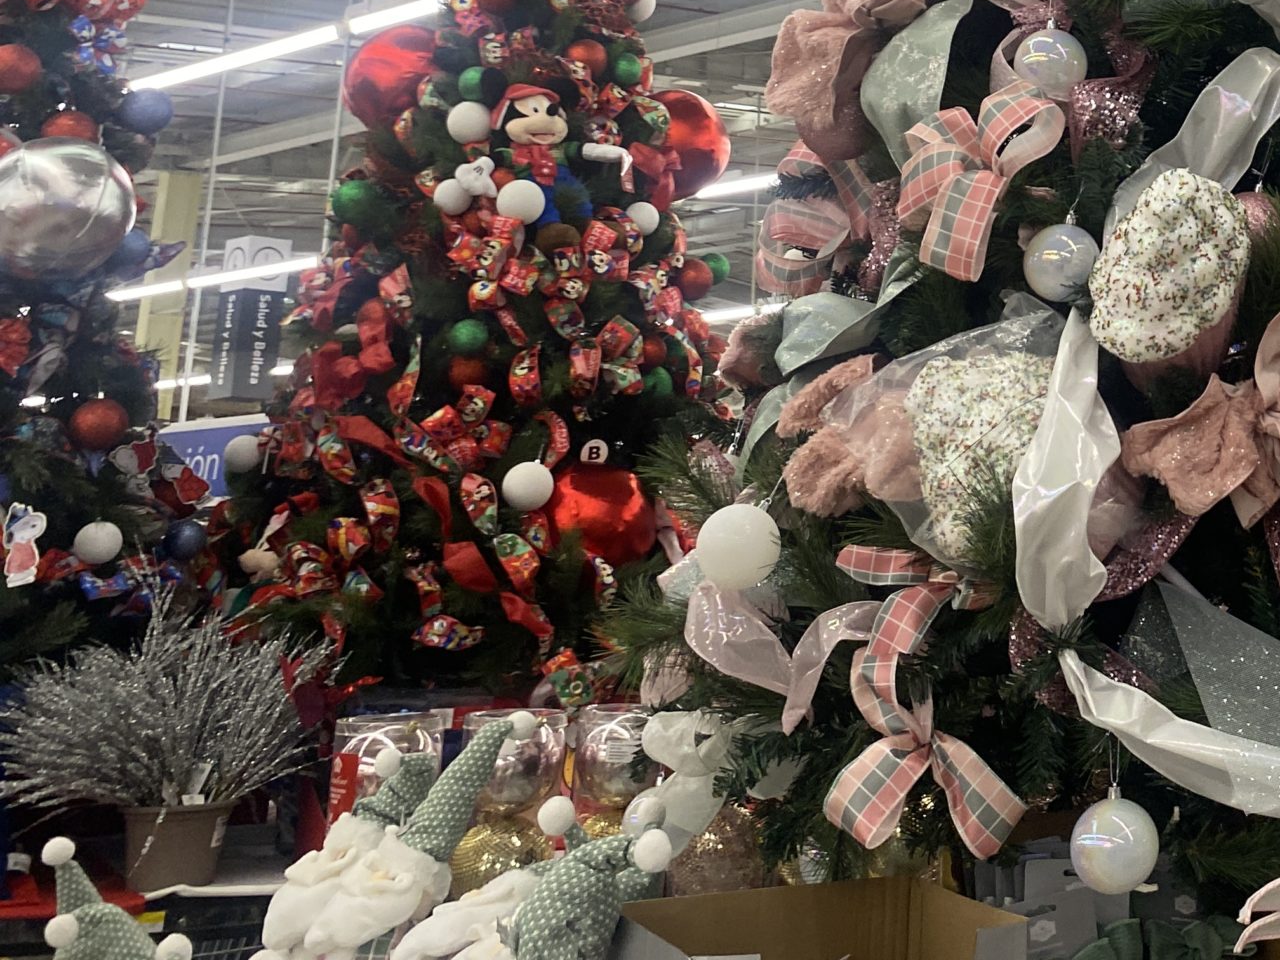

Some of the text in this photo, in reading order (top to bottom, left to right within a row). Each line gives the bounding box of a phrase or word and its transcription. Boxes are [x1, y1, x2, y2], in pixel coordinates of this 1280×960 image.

[250, 294, 272, 385] Salud y Belleza
[588, 446, 600, 461] B
